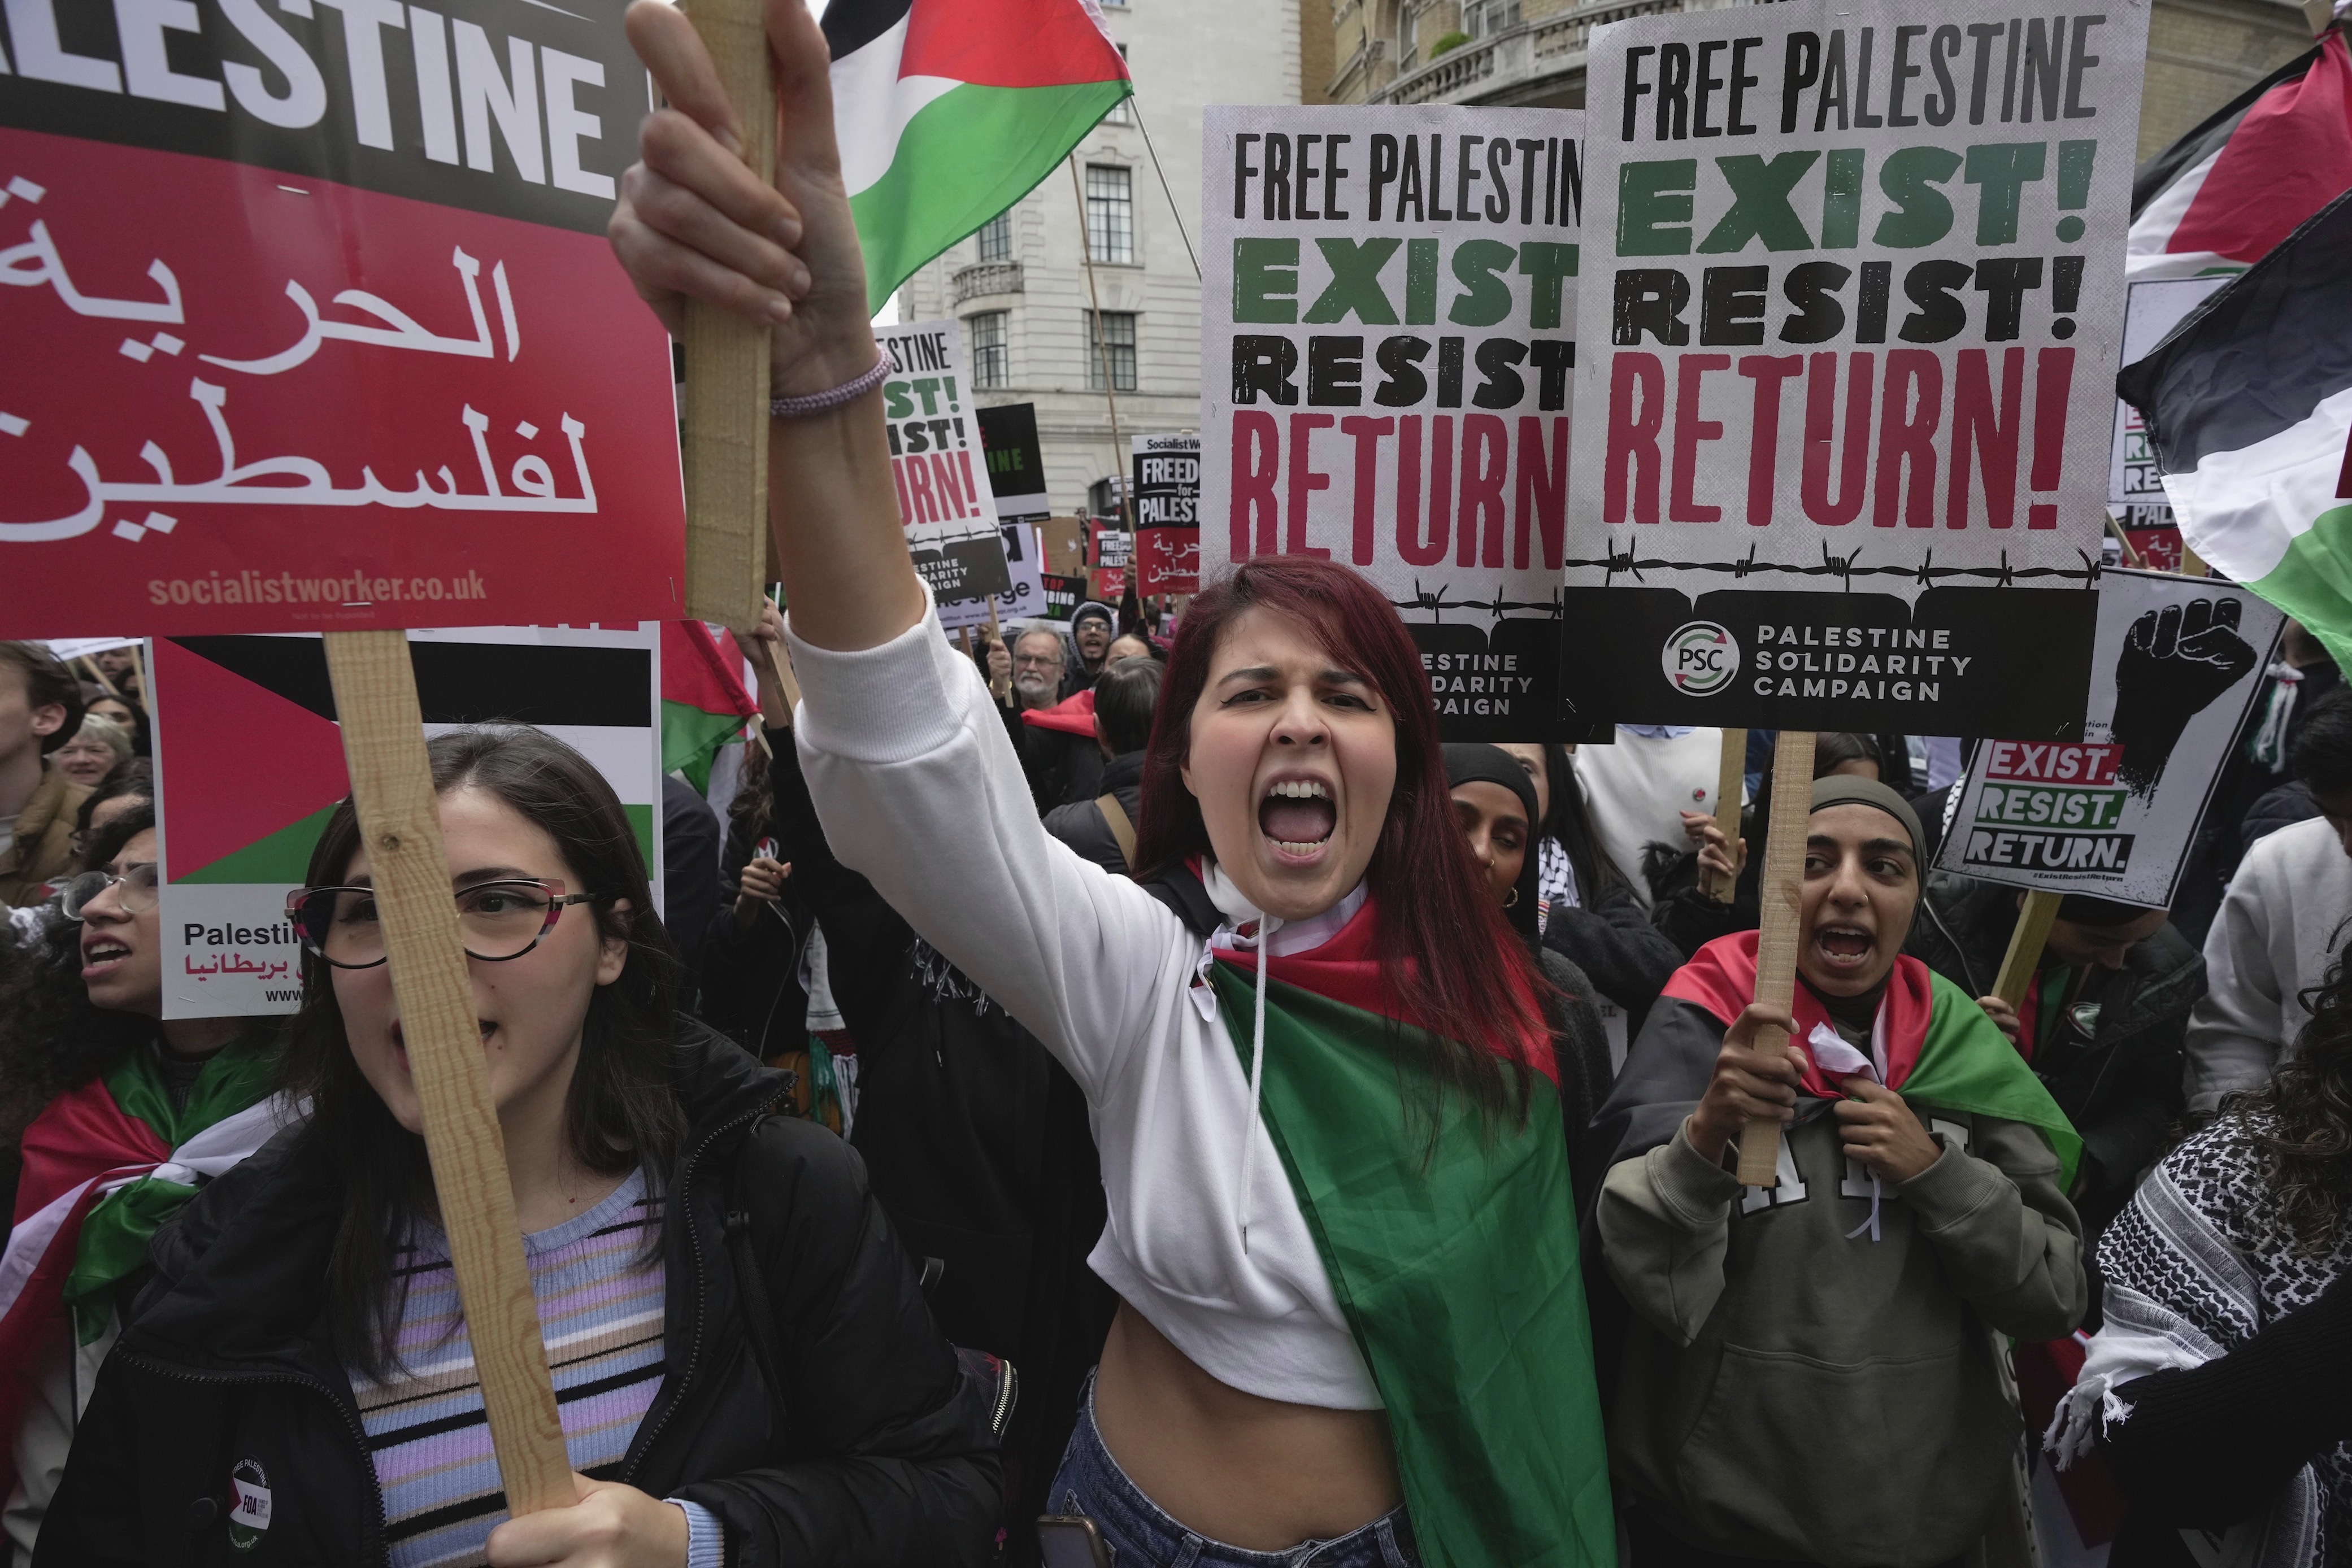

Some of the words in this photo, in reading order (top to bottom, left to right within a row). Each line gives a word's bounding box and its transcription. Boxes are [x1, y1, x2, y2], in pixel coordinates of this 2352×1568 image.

[1621, 37, 1762, 142] FREE
[1780, 15, 2106, 133] PALESTINE
[0, 0, 615, 200] LESTINE
[1234, 133, 1351, 220] FREE
[1368, 134, 1584, 227] PALESTIN
[1616, 140, 2097, 257] EXIST!
[1232, 238, 1579, 329] EXIST
[1612, 256, 2085, 346] RESIST!
[875, 332, 951, 373] STINE
[1232, 334, 1575, 410] RESIST
[1147, 438, 1188, 450] Socialist
[1603, 347, 2076, 530] RETURN!
[1142, 457, 1200, 485] FREED
[1177, 484, 1193, 496] for
[1229, 410, 1569, 570] RETURN
[148, 569, 486, 606] socialistworker.co.uk
[1044, 590, 1076, 606] BING
[1758, 624, 1950, 650] PALESTINE
[1679, 648, 1723, 671] PSC
[1755, 651, 1972, 676] SOLIDARITY
[1754, 676, 1940, 702] CAMPAIGN
[1989, 742, 2117, 781] EXIST.
[1977, 787, 2118, 825] RESIST.
[1966, 830, 2127, 869] RETURN.
[2033, 873, 2124, 882] #ExistResistReturn
[185, 952, 288, 982] بريطانيا
[245, 1458, 267, 1488] PALESTINE
[242, 1494, 257, 1516] FOA
